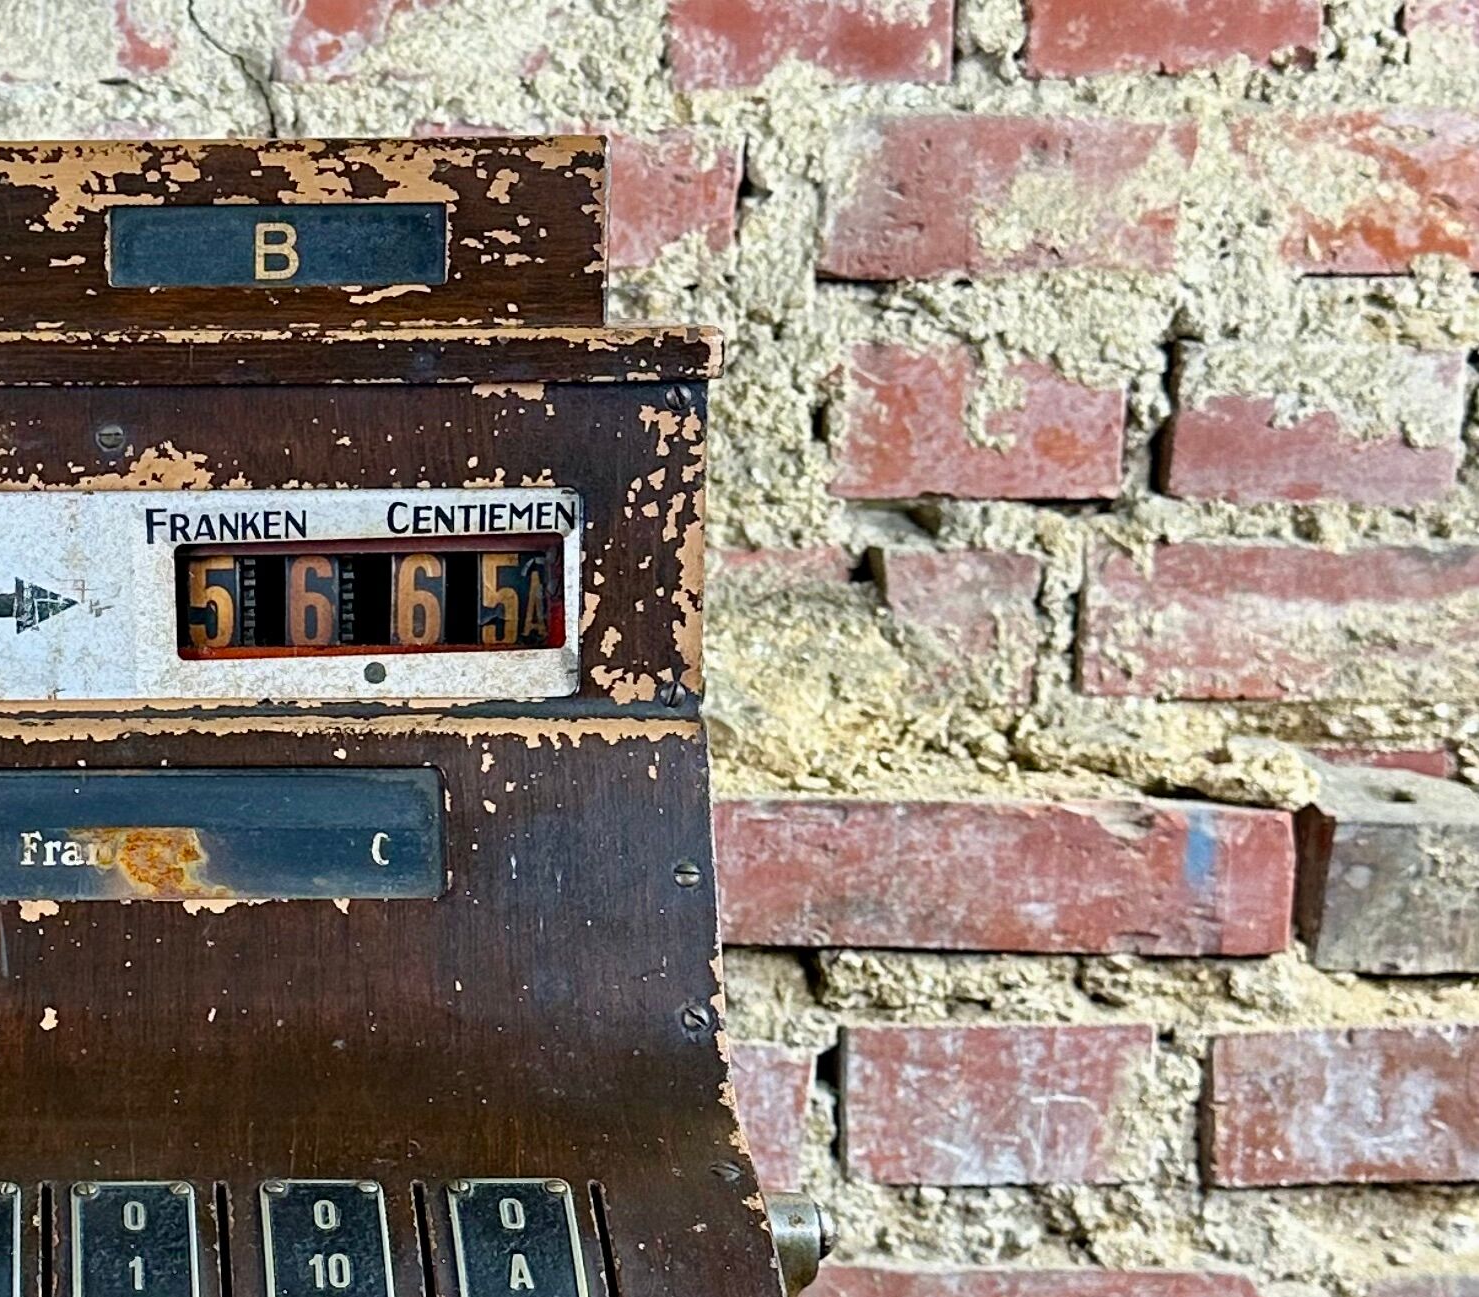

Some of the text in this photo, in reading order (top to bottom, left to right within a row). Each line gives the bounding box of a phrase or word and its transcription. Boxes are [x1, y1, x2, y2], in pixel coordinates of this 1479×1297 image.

[254, 222, 299, 280] B
[145, 500, 576, 545] FRANKEN CENTIEMEN
[188, 555, 235, 649] 5
[288, 554, 333, 647] 6
[396, 553, 444, 646] 6
[123, 1201, 145, 1230] 0
[313, 1200, 336, 1229] 0
[499, 1198, 525, 1229] 0
[128, 1256, 144, 1290] 1
[309, 1253, 351, 1288] 10
[510, 1253, 535, 1290] A
